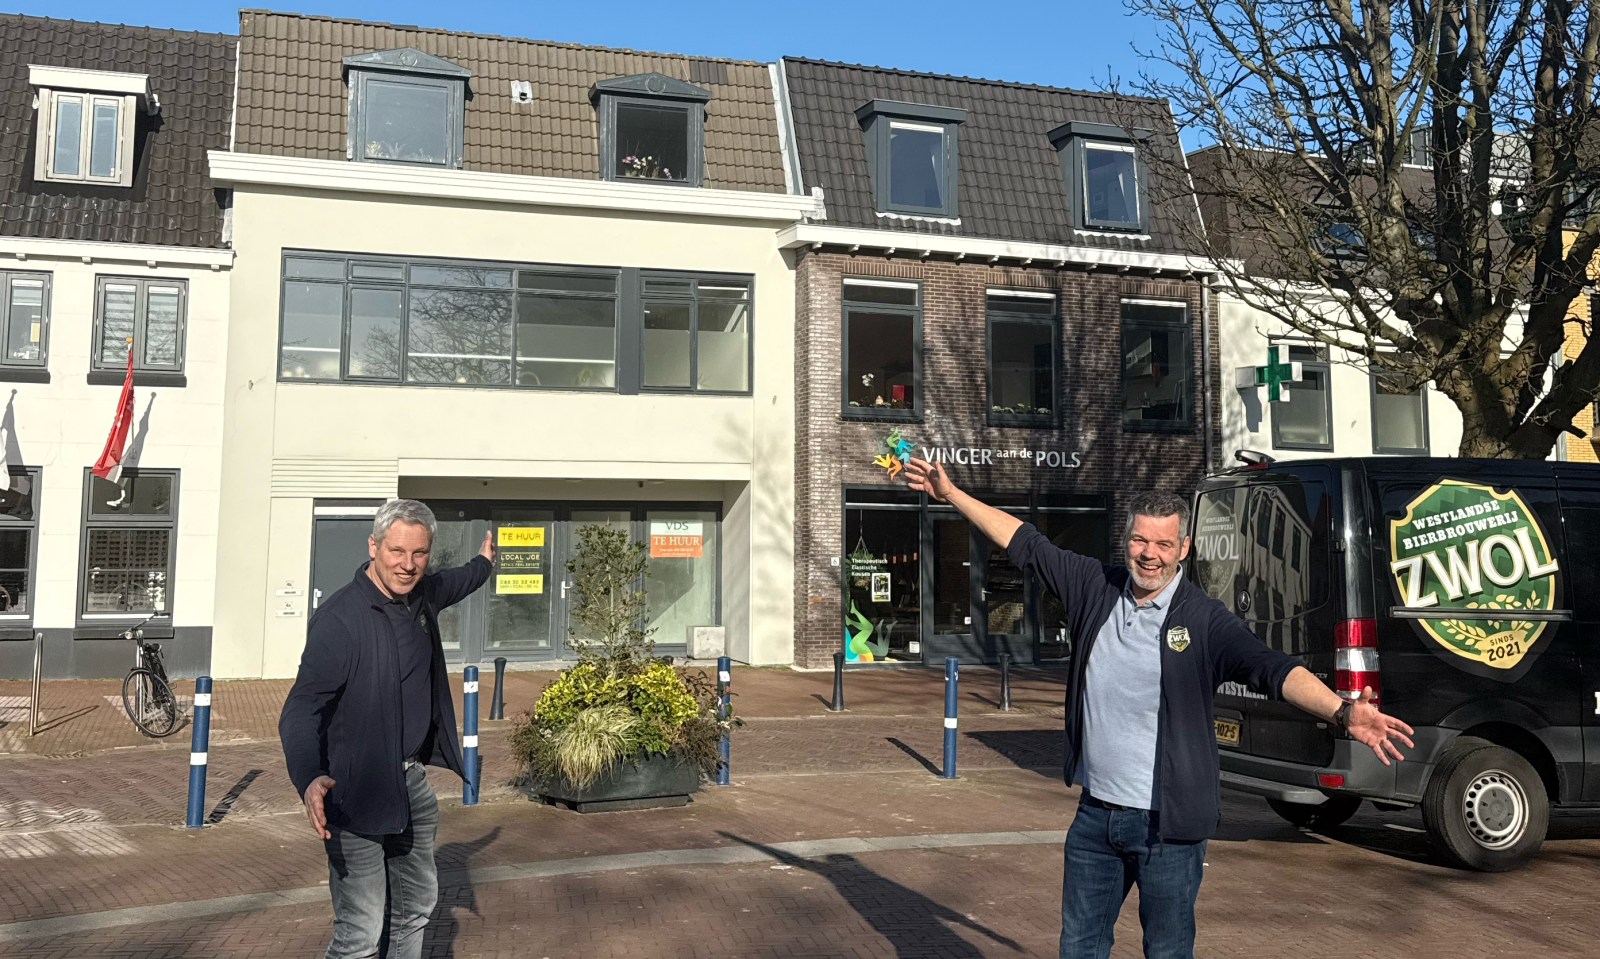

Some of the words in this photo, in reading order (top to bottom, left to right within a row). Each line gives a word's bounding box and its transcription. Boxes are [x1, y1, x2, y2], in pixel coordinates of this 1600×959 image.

[922, 446, 993, 465] VINGER
[996, 449, 1017, 459] aan
[1019, 447, 1033, 459] de
[1035, 450, 1081, 468] POLS
[665, 521, 689, 531] VDS
[1412, 500, 1500, 531] WESTLANDSE
[501, 533, 513, 541] TE
[516, 533, 541, 541] HUUR
[653, 536, 667, 546] TE
[669, 536, 700, 546] HUUR
[1402, 511, 1519, 550] BIERBROUWERIJ
[1196, 533, 1239, 561] ZWOL
[1390, 526, 1559, 608] ZWOL
[1489, 634, 1514, 646] SINDS
[1487, 641, 1521, 662] 2021
